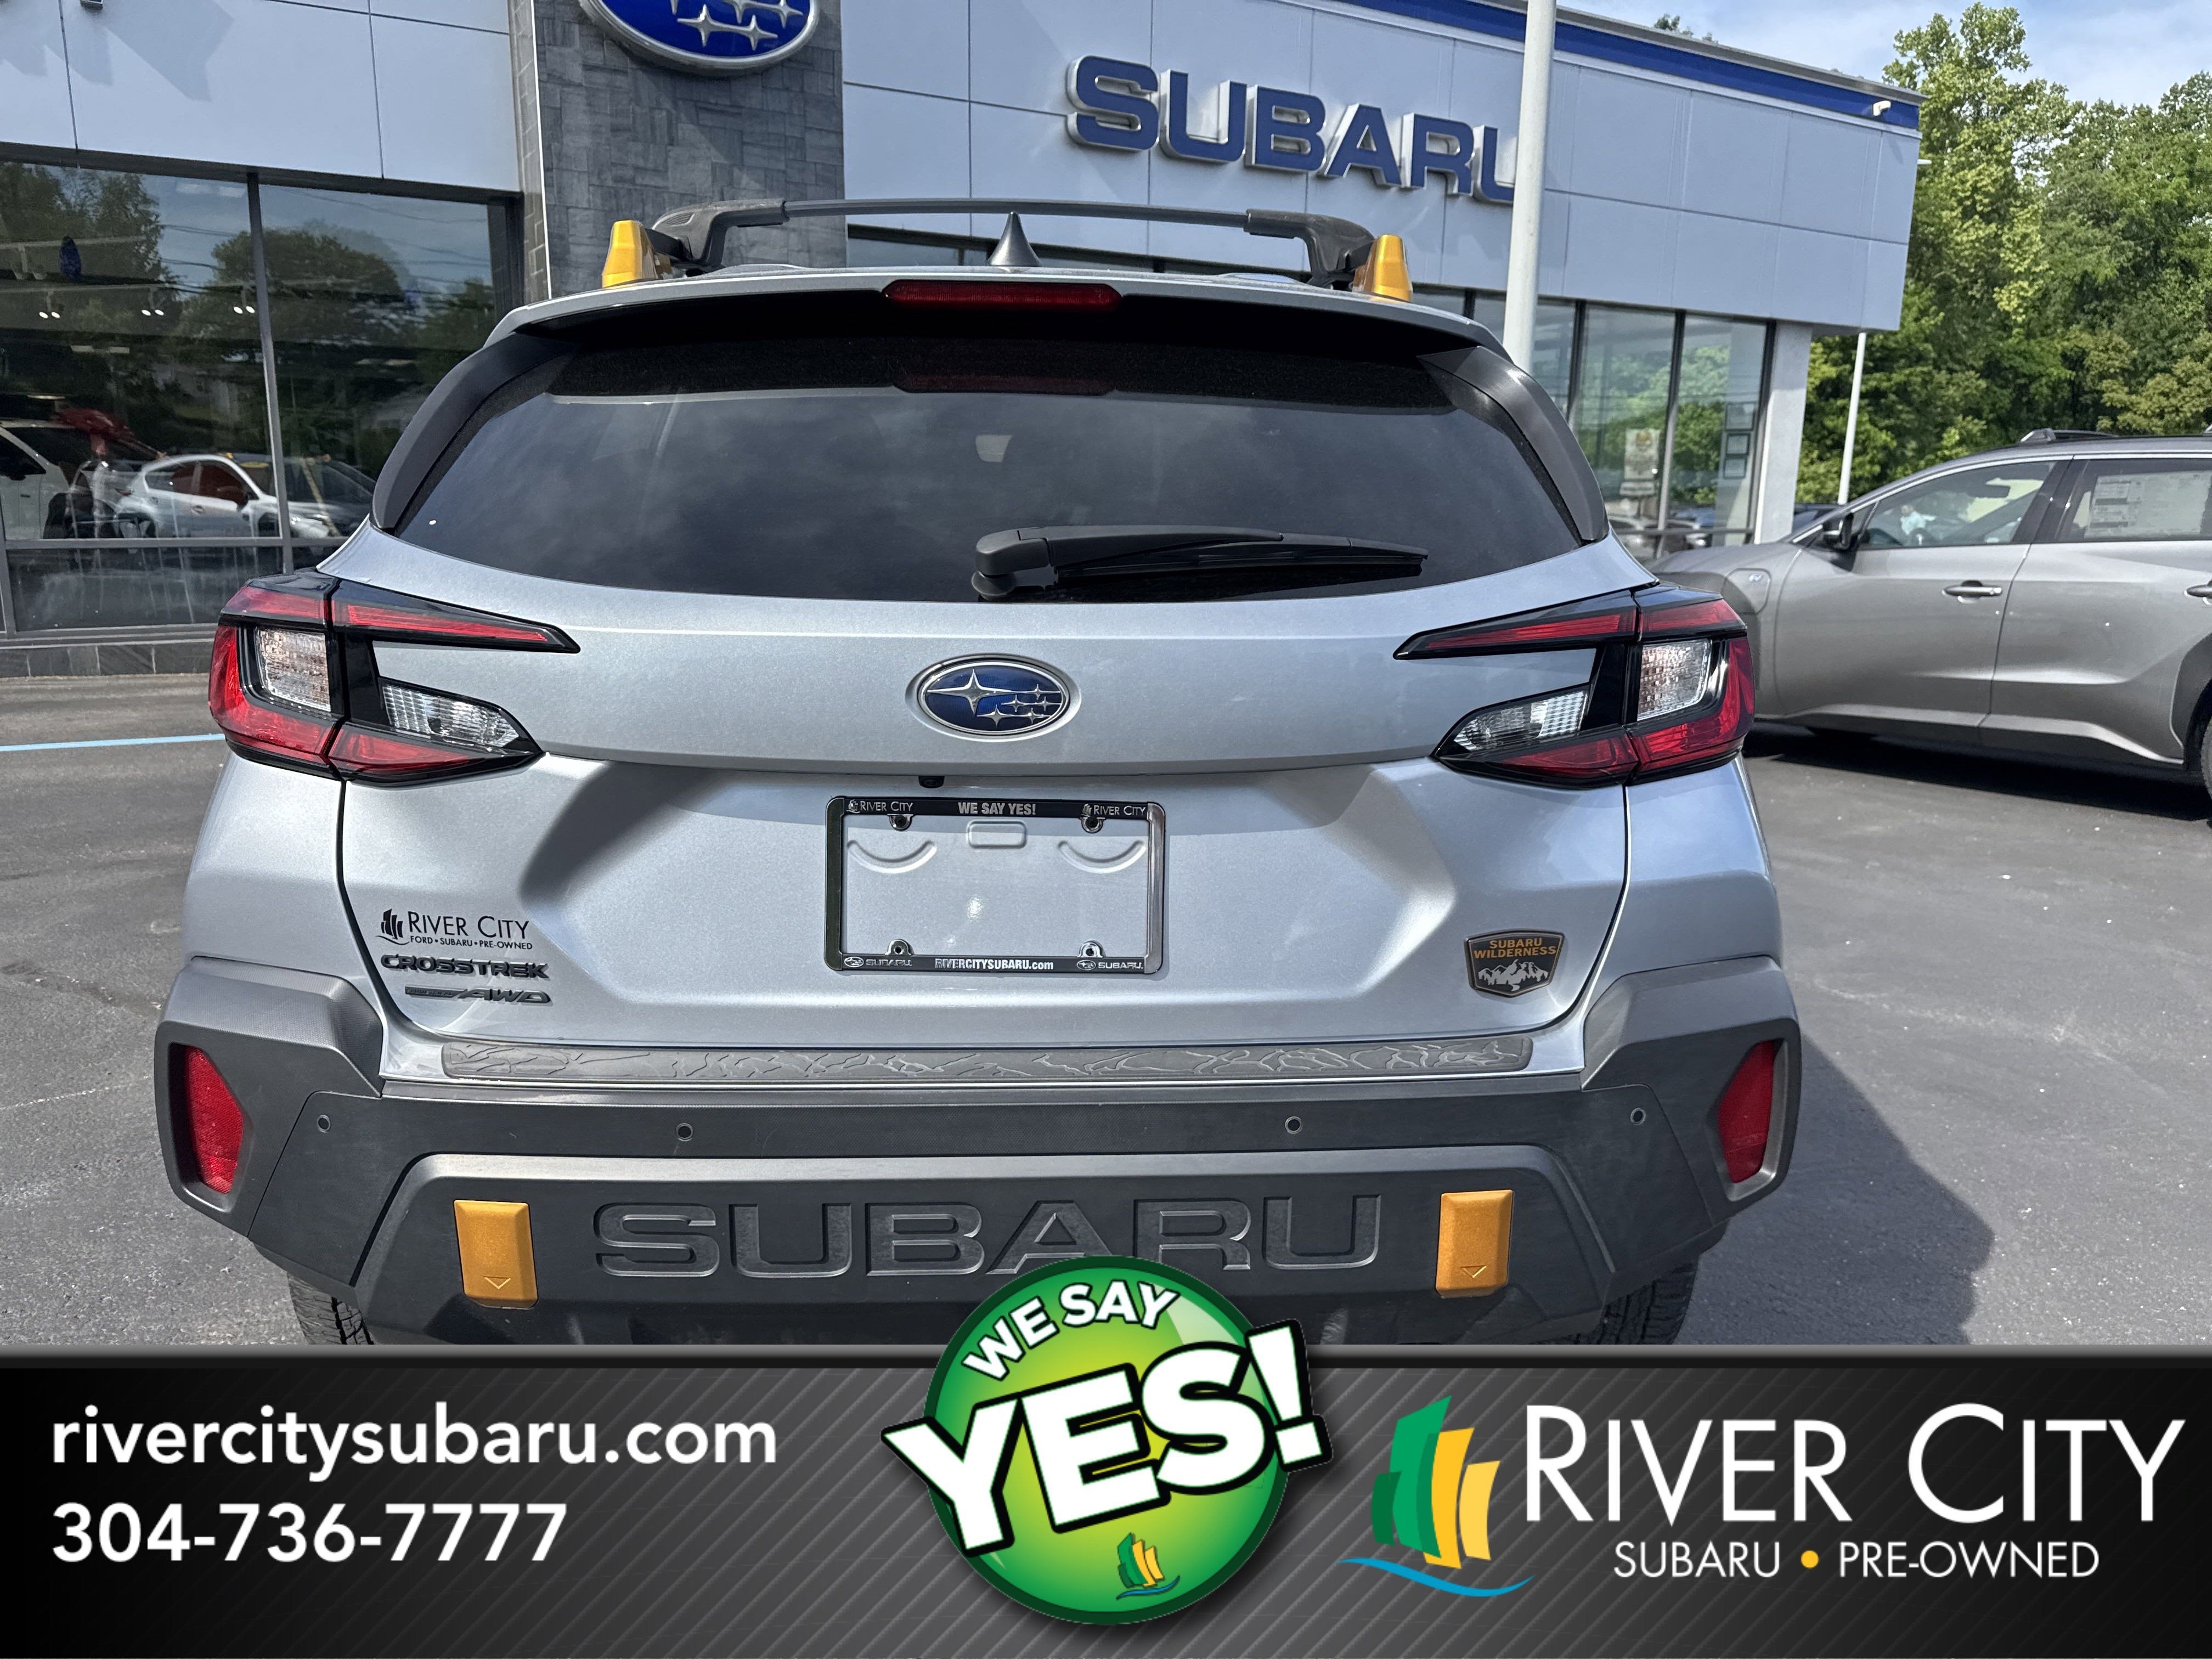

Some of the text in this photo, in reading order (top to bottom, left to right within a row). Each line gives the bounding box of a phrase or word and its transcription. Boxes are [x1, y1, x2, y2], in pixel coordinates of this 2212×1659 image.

[860, 801, 913, 812] RIVER CITY
[958, 802, 1036, 815] WE SAY YES!
[1093, 805, 1146, 816] RIVER CITY
[408, 911, 529, 939] RIVER CITY
[410, 935, 533, 950] FORD SUBARU PRE-OWNED
[1489, 938, 1542, 950] SUBARU
[1474, 946, 1556, 959] WILDERNESS
[380, 953, 550, 979] CROSSTREK
[934, 958, 1054, 970] RIVERCITYSUBARU.com
[458, 988, 552, 1004] AWD
[593, 1195, 1381, 1279] SUBARU
